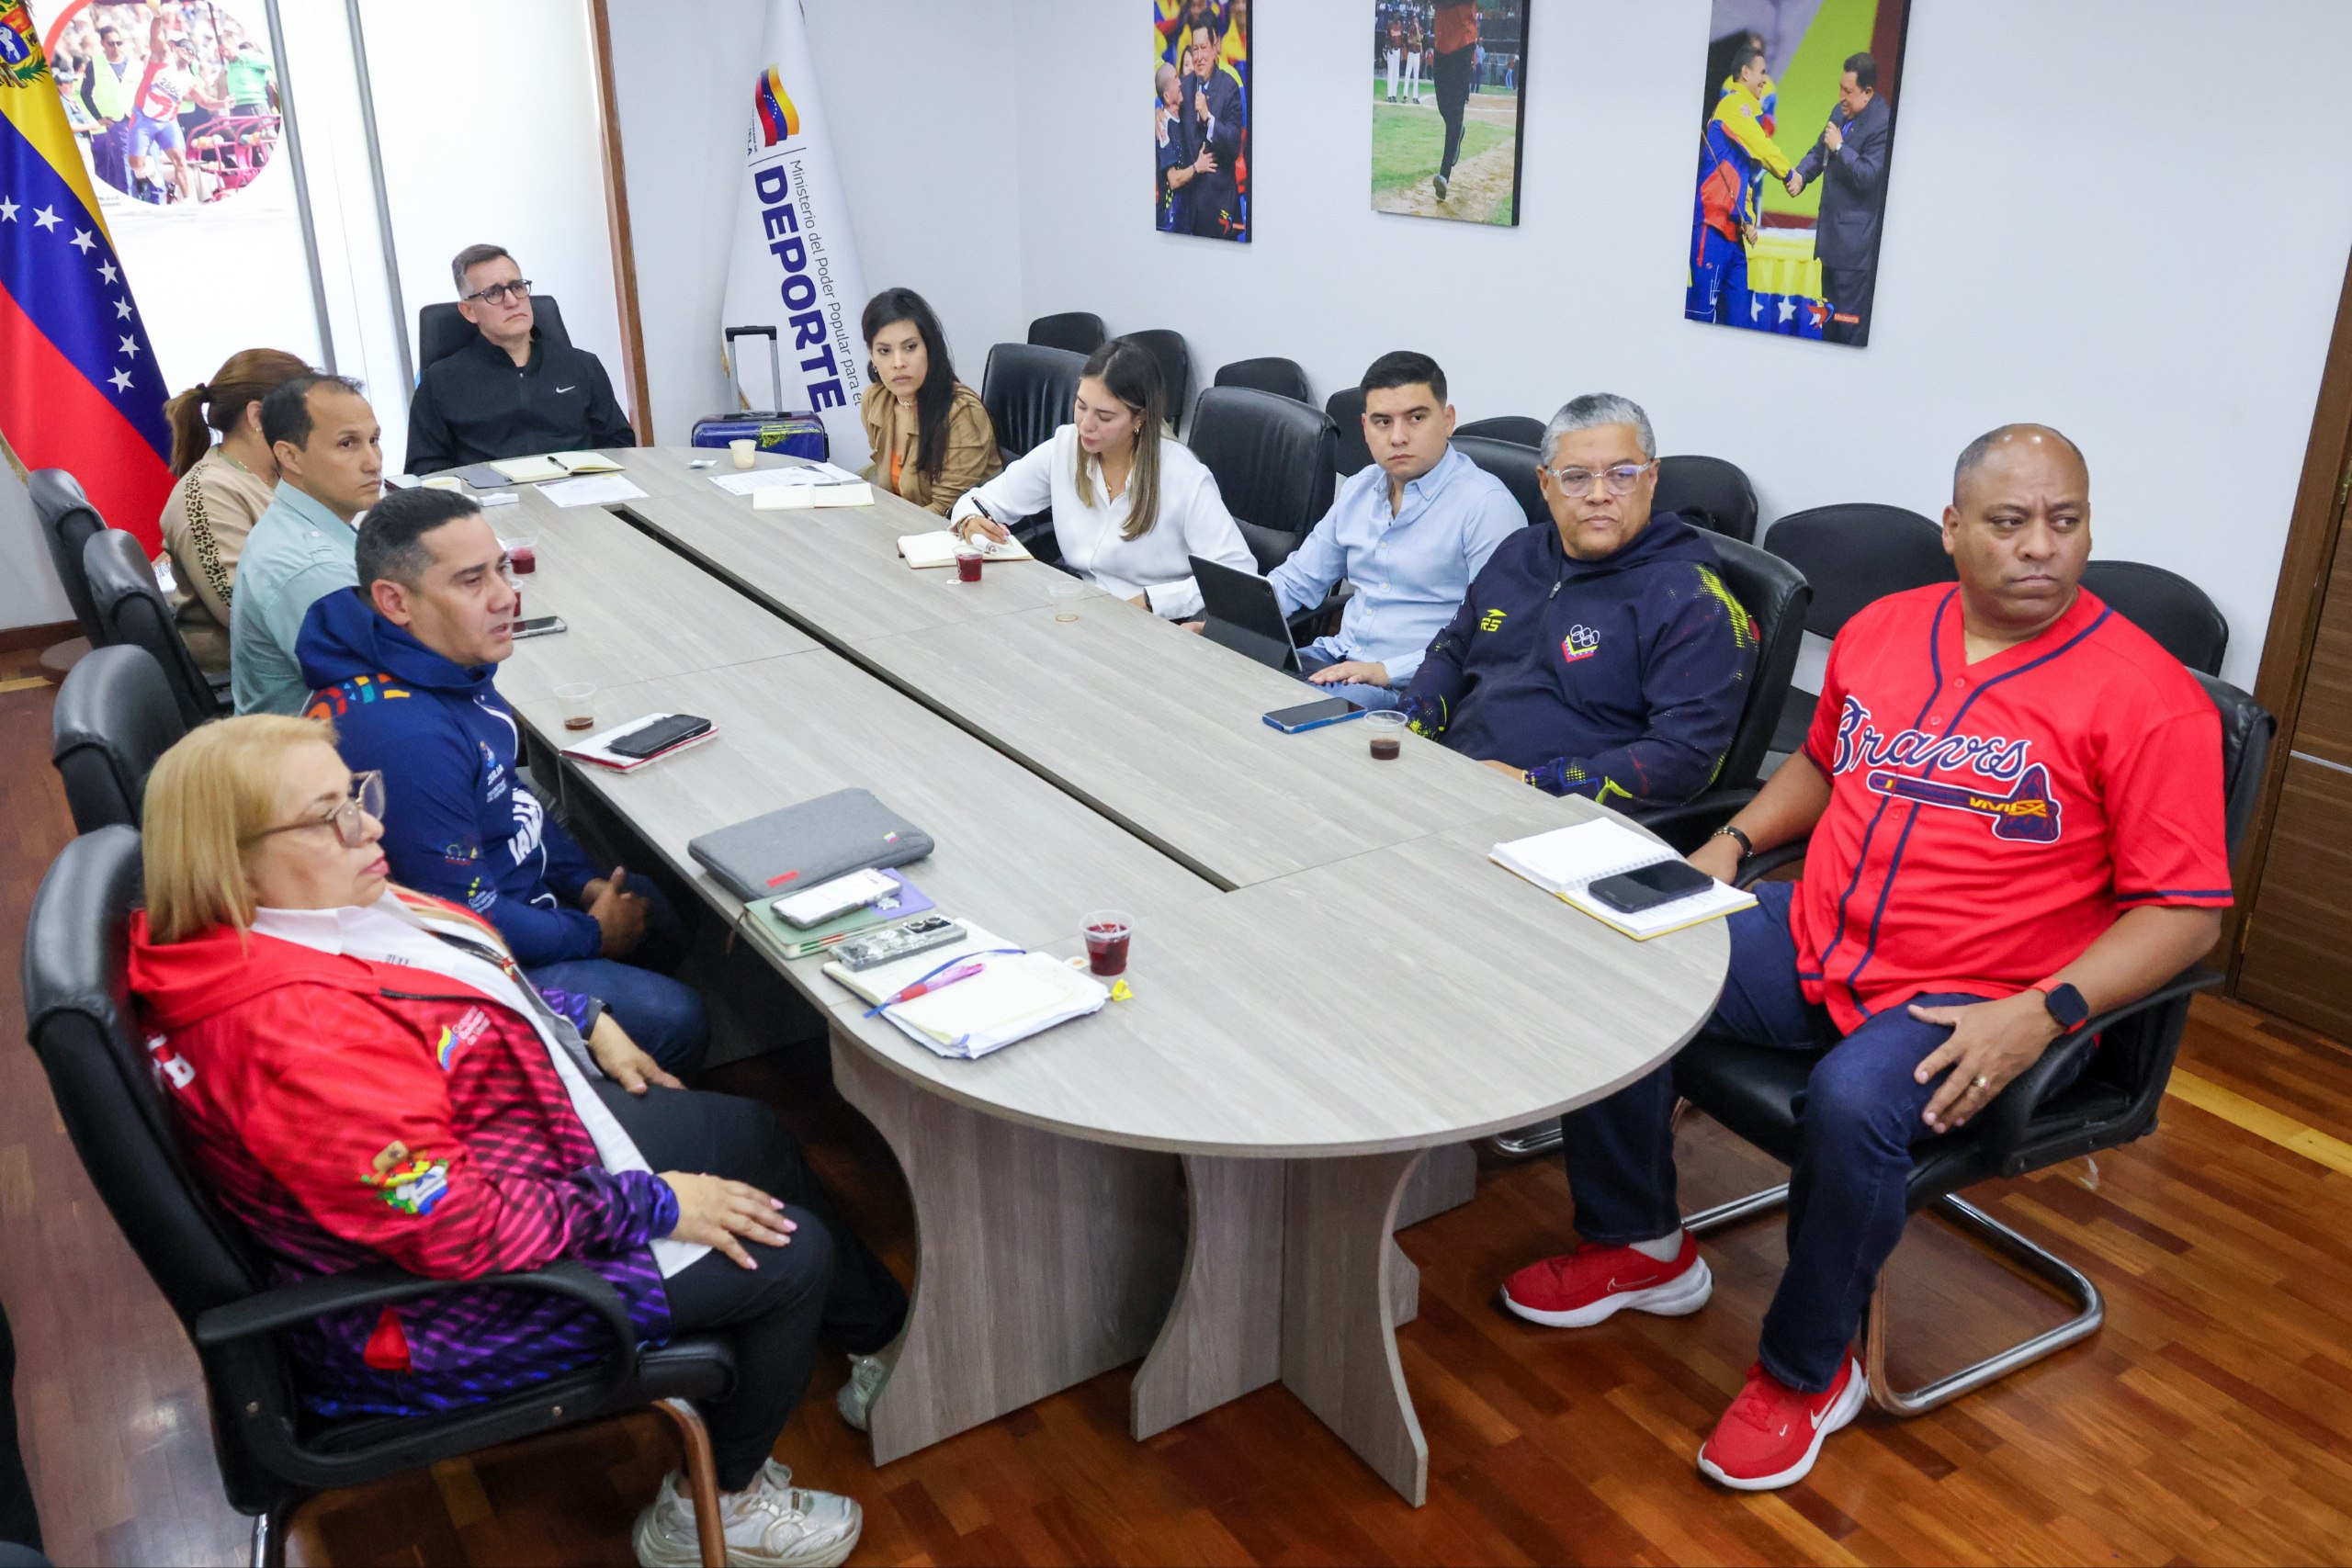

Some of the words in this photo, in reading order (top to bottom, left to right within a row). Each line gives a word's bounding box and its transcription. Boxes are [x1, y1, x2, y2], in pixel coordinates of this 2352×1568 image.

[789, 159, 816, 229] Ministerio
[808, 232, 825, 254] del
[753, 164, 847, 413] DEPORTE
[815, 256, 835, 299] Poder
[827, 301, 851, 355] Popular
[840, 358, 860, 390] para
[1832, 694, 2032, 782] Braves
